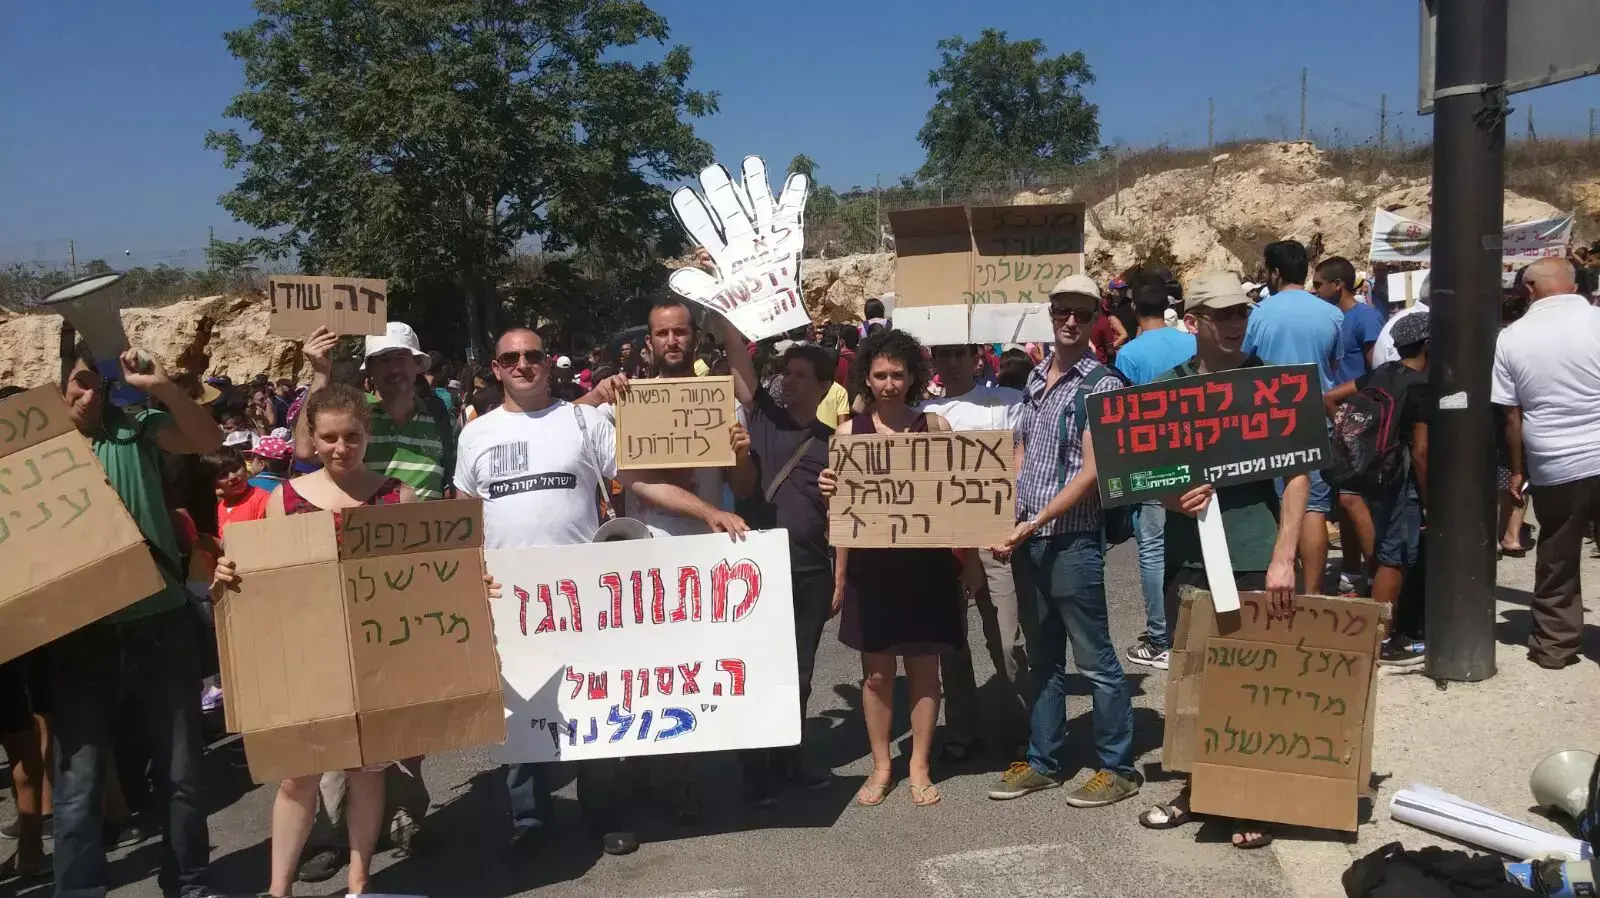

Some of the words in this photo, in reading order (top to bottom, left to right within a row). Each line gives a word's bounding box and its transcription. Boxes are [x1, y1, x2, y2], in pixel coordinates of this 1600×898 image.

[975, 258, 1074, 287] ממשלתי
[269, 280, 321, 314] שוד!
[332, 284, 385, 315] זה
[679, 387, 725, 406] מתווה
[1100, 381, 1234, 424] להיכנע
[1253, 372, 1309, 407] לא
[1116, 407, 1297, 455] לטייקונים!
[829, 438, 895, 476] ישראל
[905, 434, 1008, 473] אזרחי
[1177, 464, 1190, 474] די
[1203, 457, 1267, 484] מספיק!
[1269, 446, 1322, 470] תרמנו
[512, 479, 538, 491] יקרה
[540, 475, 573, 487] ישראל
[845, 478, 915, 505] מהגז
[936, 474, 1012, 515] קיבלו
[888, 513, 931, 544] רק
[513, 578, 583, 636] הגז
[597, 557, 763, 632] מתווה
[360, 611, 471, 646] מדינה
[1207, 645, 1278, 673] תשובה
[1295, 637, 1357, 680] אצל
[565, 665, 609, 701] של
[1203, 715, 1341, 765] בממשלה
